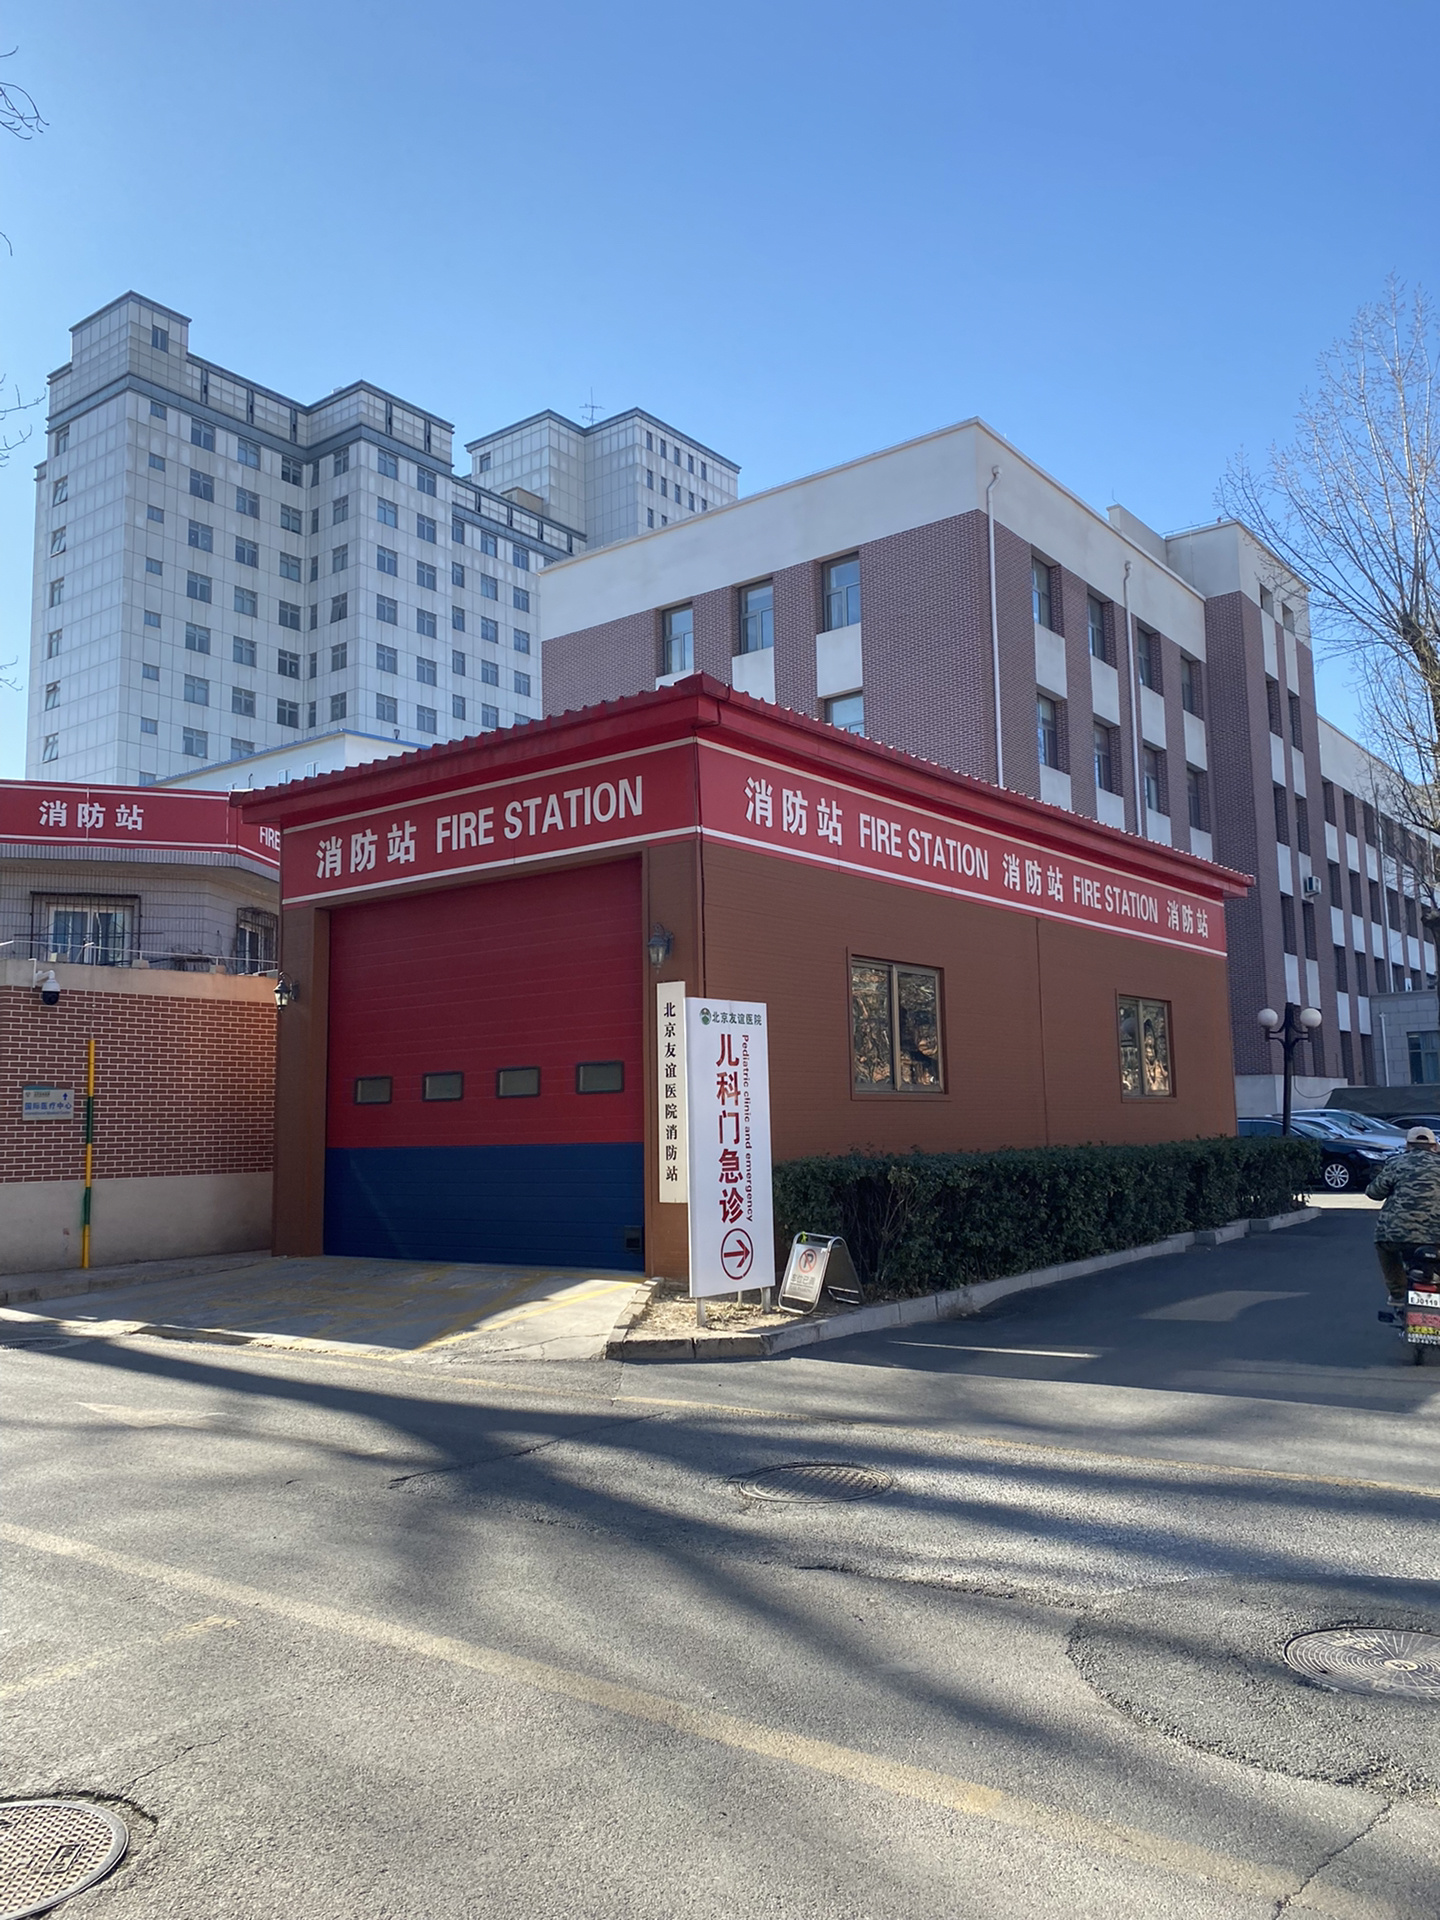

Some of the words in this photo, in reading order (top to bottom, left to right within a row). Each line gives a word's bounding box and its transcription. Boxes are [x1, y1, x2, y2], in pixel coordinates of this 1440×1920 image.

[38, 800, 144, 831] 消防站
[316, 820, 417, 879] 消防站
[436, 806, 494, 854] FIRE
[504, 775, 643, 839] STATION
[744, 776, 843, 846] 消防站
[859, 812, 903, 858] FIRE
[908, 827, 989, 880] STATION
[1002, 853, 1064, 903] 消防站
[1073, 875, 1102, 910] FIRE
[1104, 884, 1158, 924] STATION
[1166, 899, 1209, 938] 消防站
[711, 1011, 763, 1026] 北京友谊医院
[742, 1034, 750, 1087] Pediatric
[663, 1002, 678, 1182] 北京友谊医院消防站
[743, 1091, 751, 1123] clinic
[716, 1033, 745, 1224] 儿科门急诊
[744, 1126, 753, 1149] and
[745, 1153, 754, 1222] emergency
